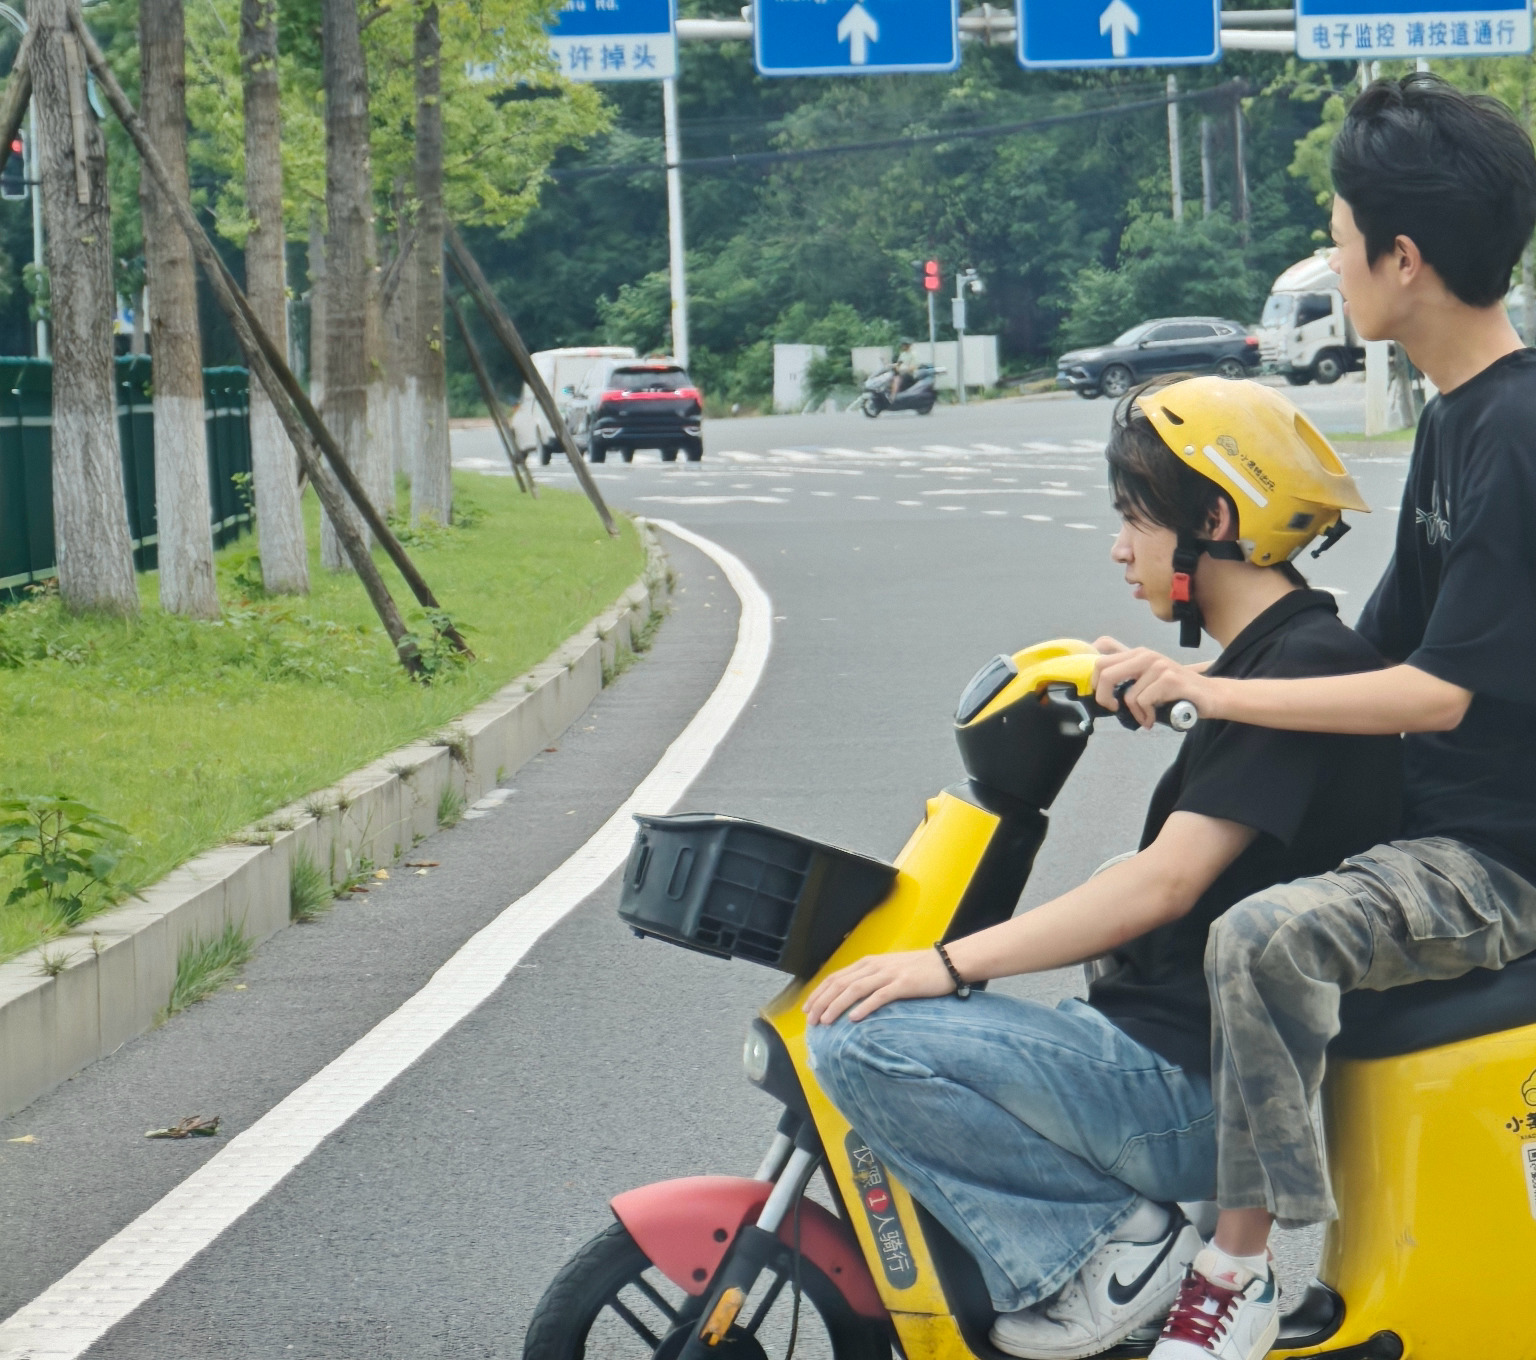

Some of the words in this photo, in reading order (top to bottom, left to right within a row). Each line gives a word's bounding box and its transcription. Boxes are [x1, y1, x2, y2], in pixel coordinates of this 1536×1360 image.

[1312, 22, 1395, 49] 电子监控
[1406, 19, 1515, 46] 请按道通行
